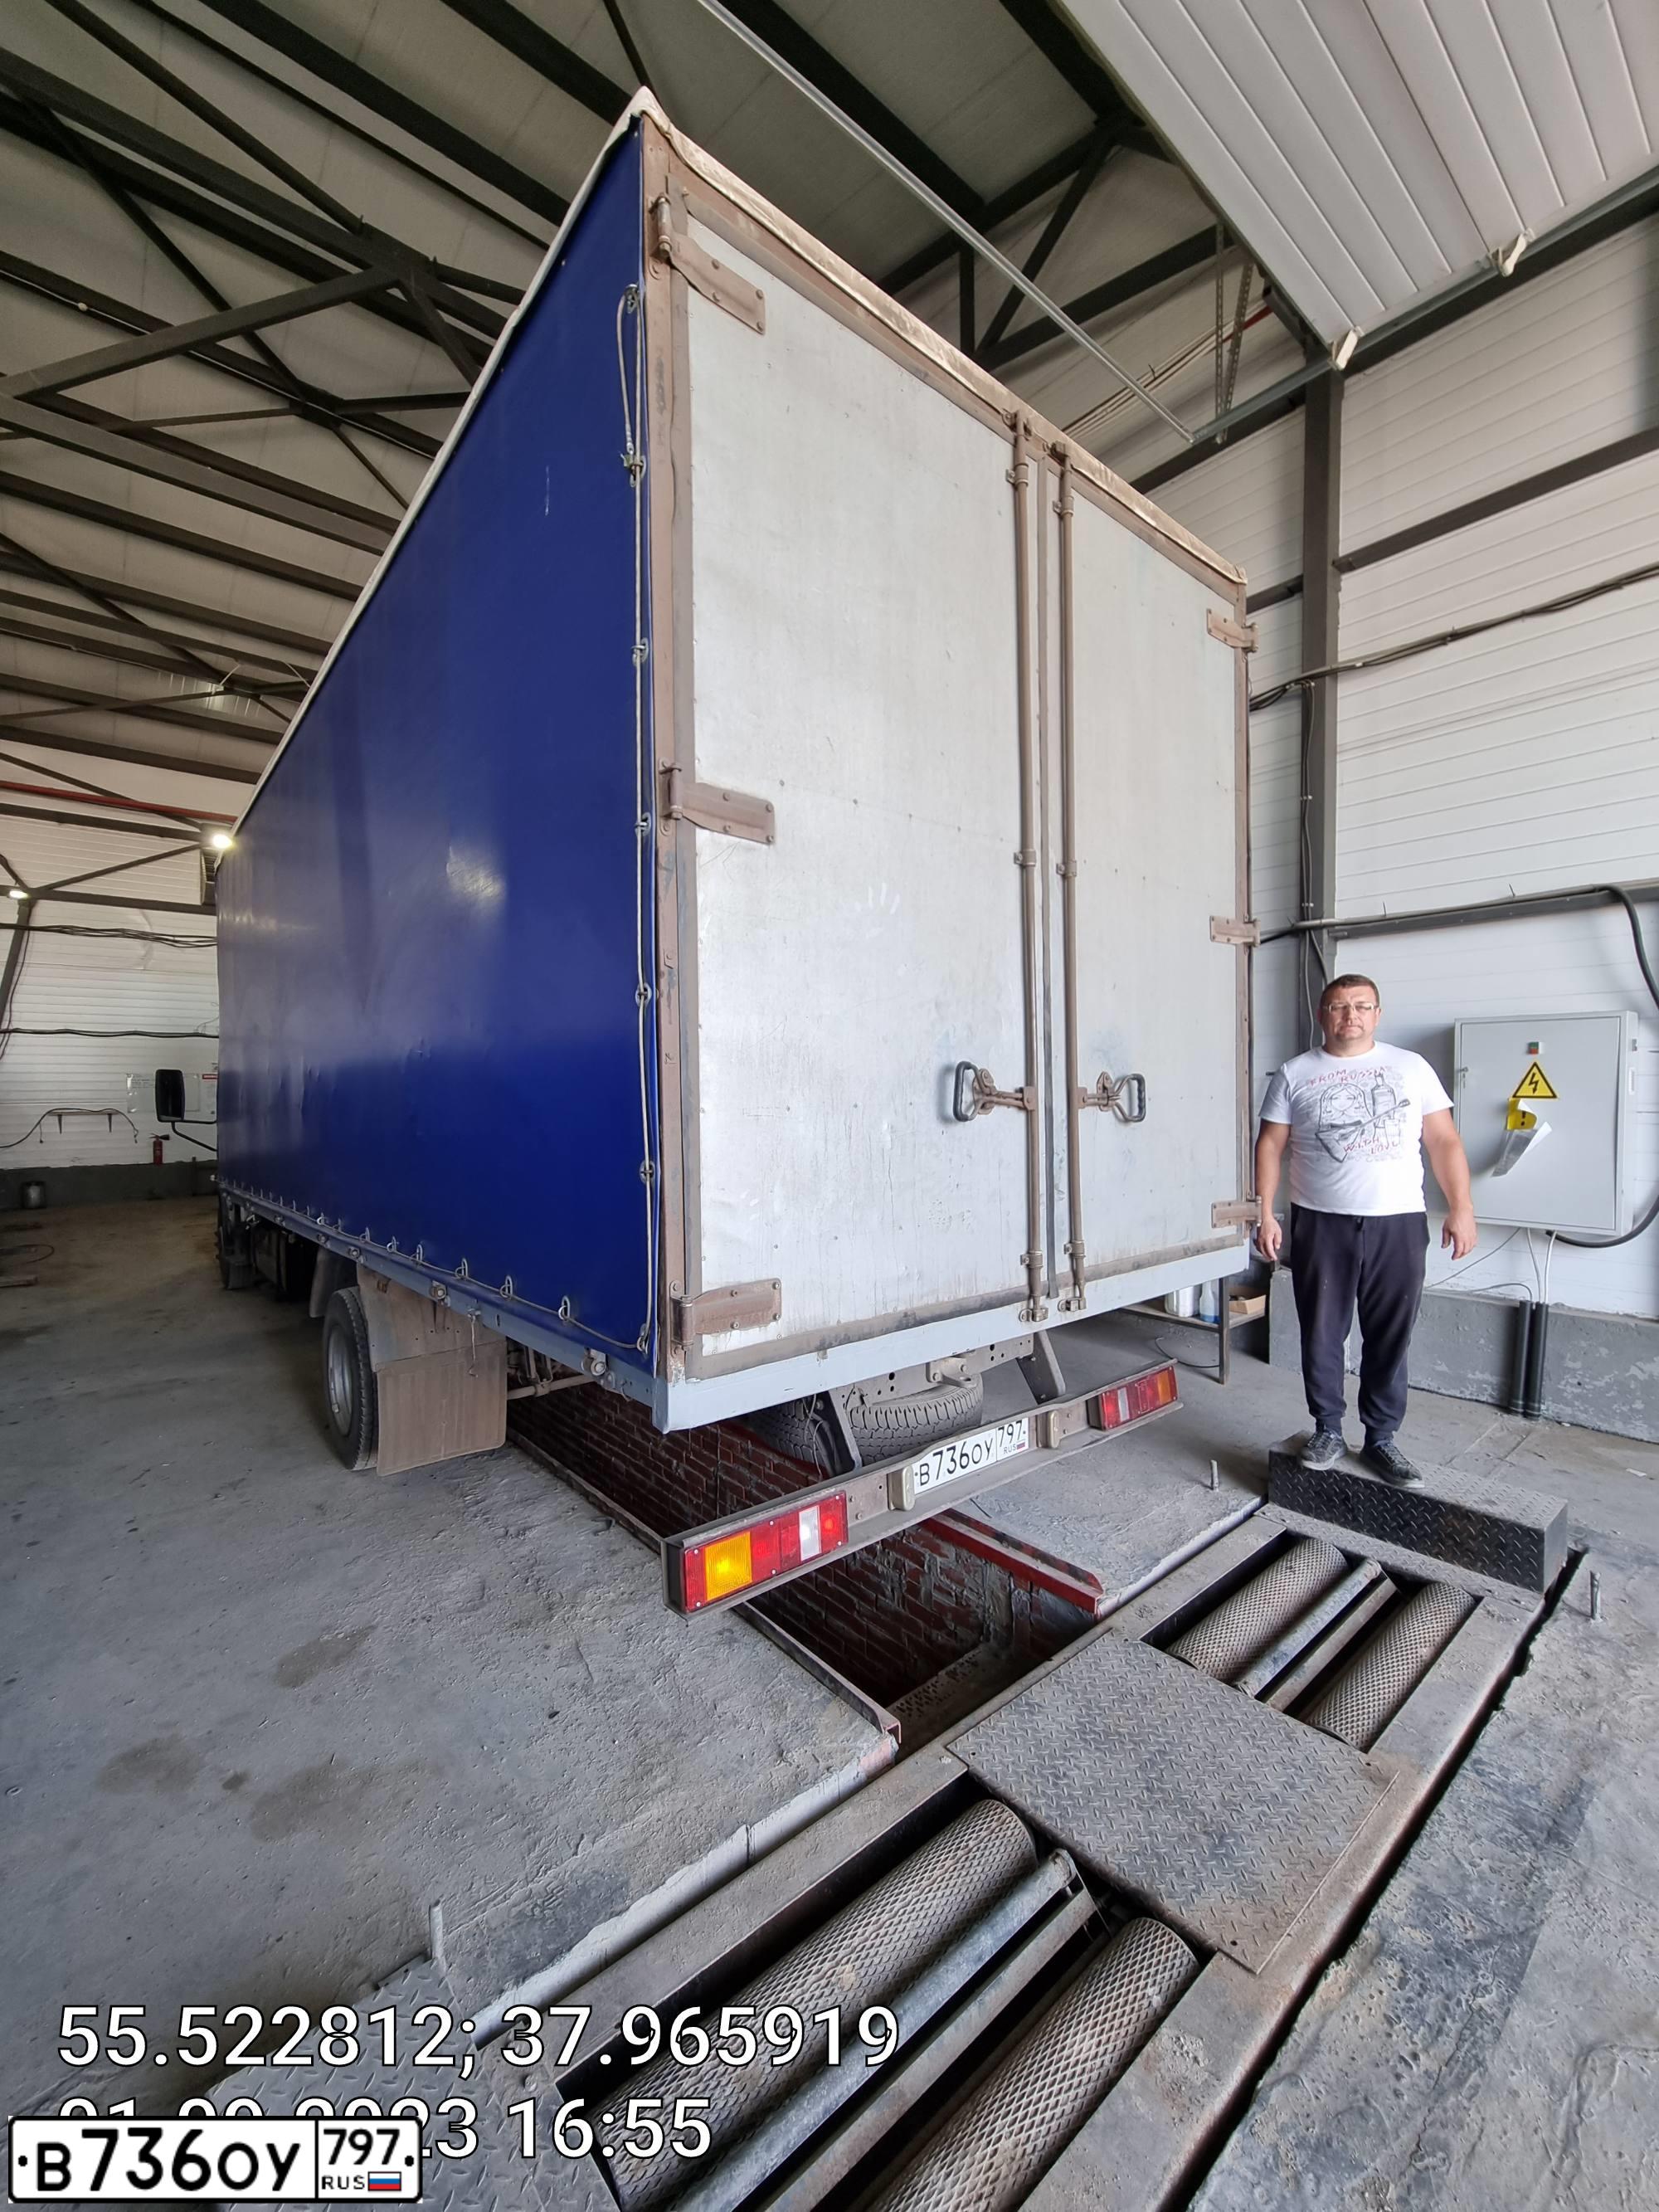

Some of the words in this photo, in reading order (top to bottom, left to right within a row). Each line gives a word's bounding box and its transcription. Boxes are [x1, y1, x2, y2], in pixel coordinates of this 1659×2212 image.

[1310, 1069, 1347, 1087] FROM
[997, 1420, 1023, 1448] 797
[1003, 1444, 1017, 1454] RUS
